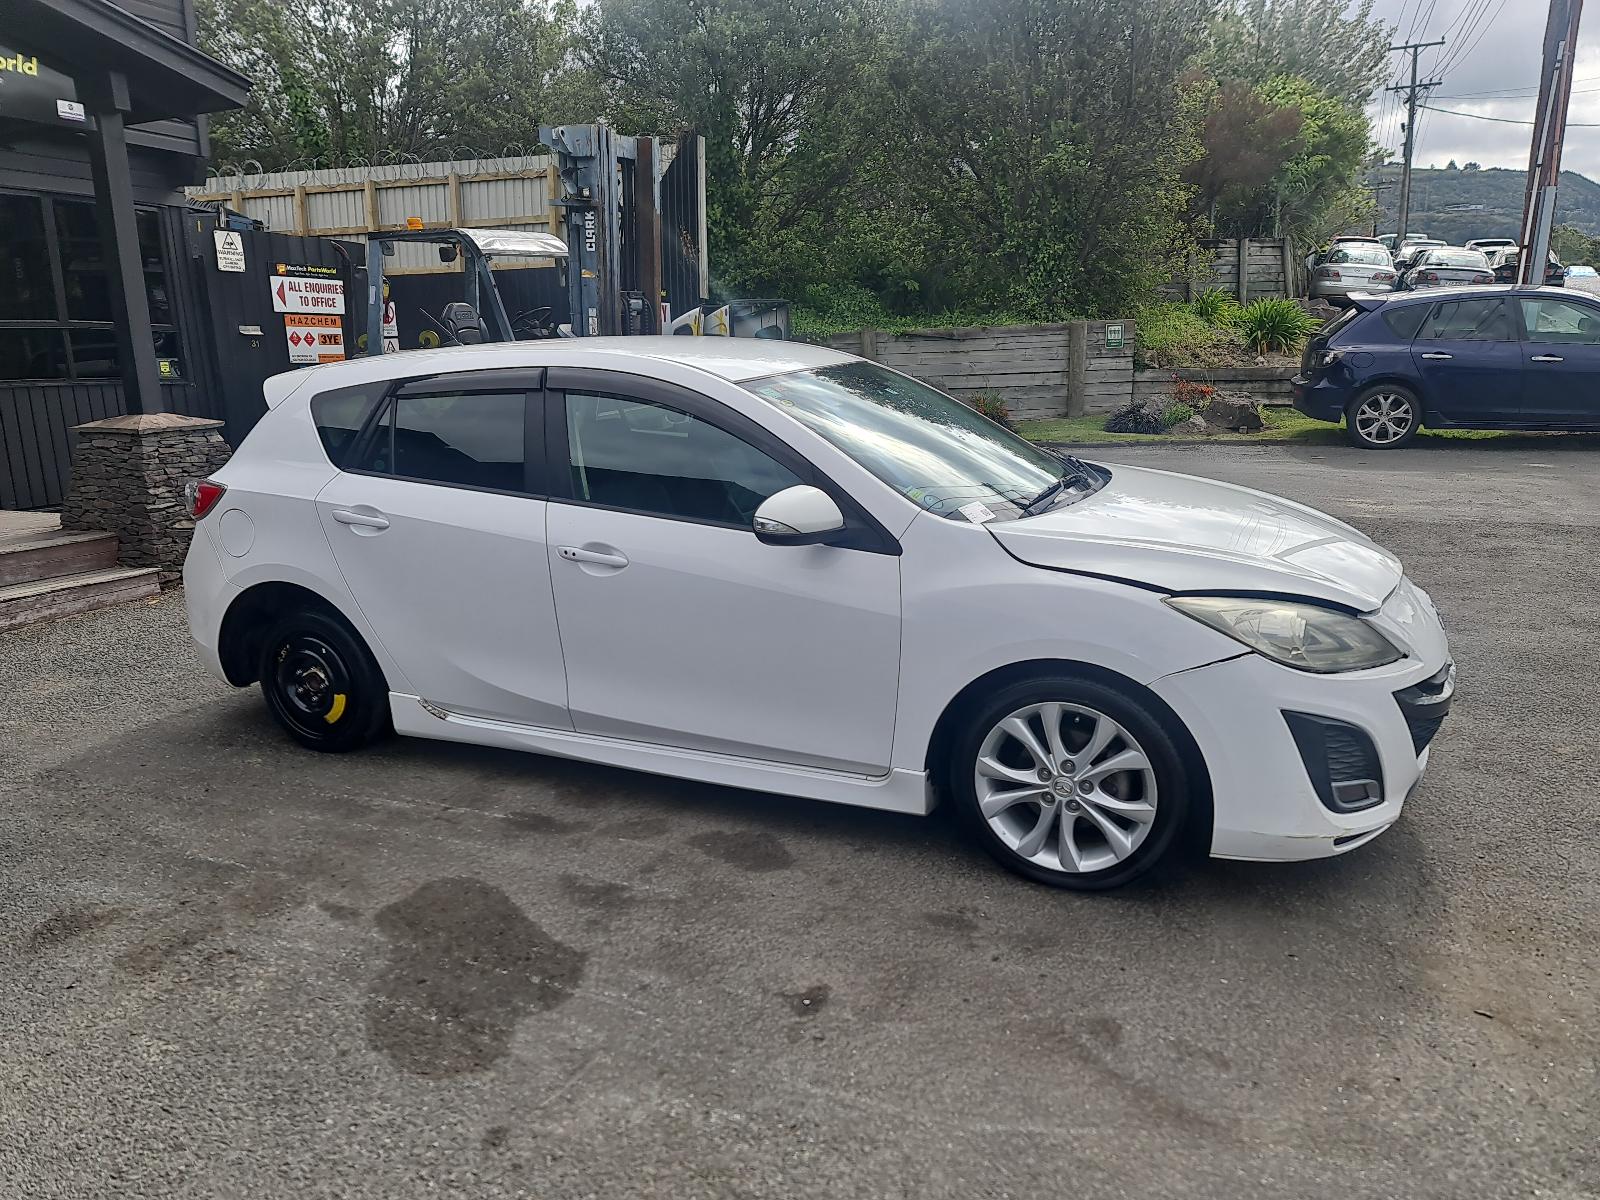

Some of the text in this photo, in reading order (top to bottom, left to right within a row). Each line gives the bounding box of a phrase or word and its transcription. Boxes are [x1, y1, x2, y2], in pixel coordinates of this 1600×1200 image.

[584, 211, 596, 252] CLARK
[217, 249, 243, 257] WARNING
[307, 266, 337, 274] PartsWorld
[288, 281, 345, 295] ALL ENQUIRIES
[299, 296, 337, 308] TO OFFICE
[289, 316, 337, 326] HAZCHEM
[320, 334, 340, 344] 3YE
